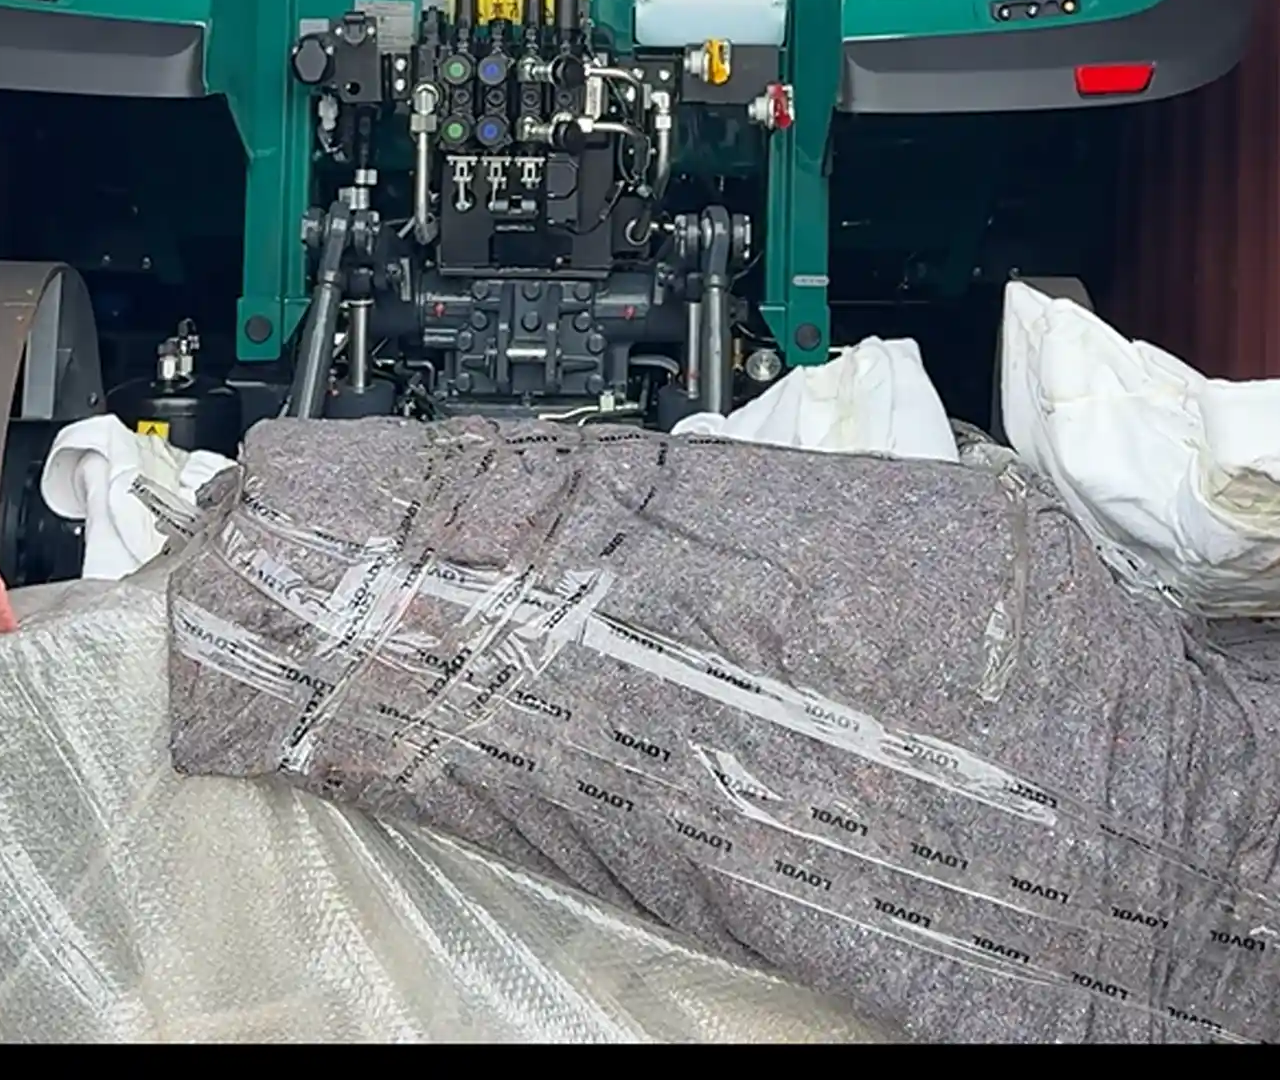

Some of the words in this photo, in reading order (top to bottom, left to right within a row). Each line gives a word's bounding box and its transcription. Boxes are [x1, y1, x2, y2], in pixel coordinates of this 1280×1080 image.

[803, 703, 862, 734] LOVOL
[477, 740, 537, 774] LOVOL
[613, 729, 672, 764] LOVOL
[575, 778, 635, 814] LOVOL
[673, 817, 734, 854] LOVOL
[809, 805, 869, 838] LOVOL
[909, 840, 969, 871] LOVOL
[773, 858, 833, 892] LOVOL
[1008, 874, 1070, 905] LOVOL
[872, 896, 933, 930] LOVOL
[1110, 905, 1170, 930] LOVOL
[971, 933, 1031, 966] LOVOL
[1208, 929, 1267, 953] LOVOL
[1070, 970, 1129, 1003] LOVOL
